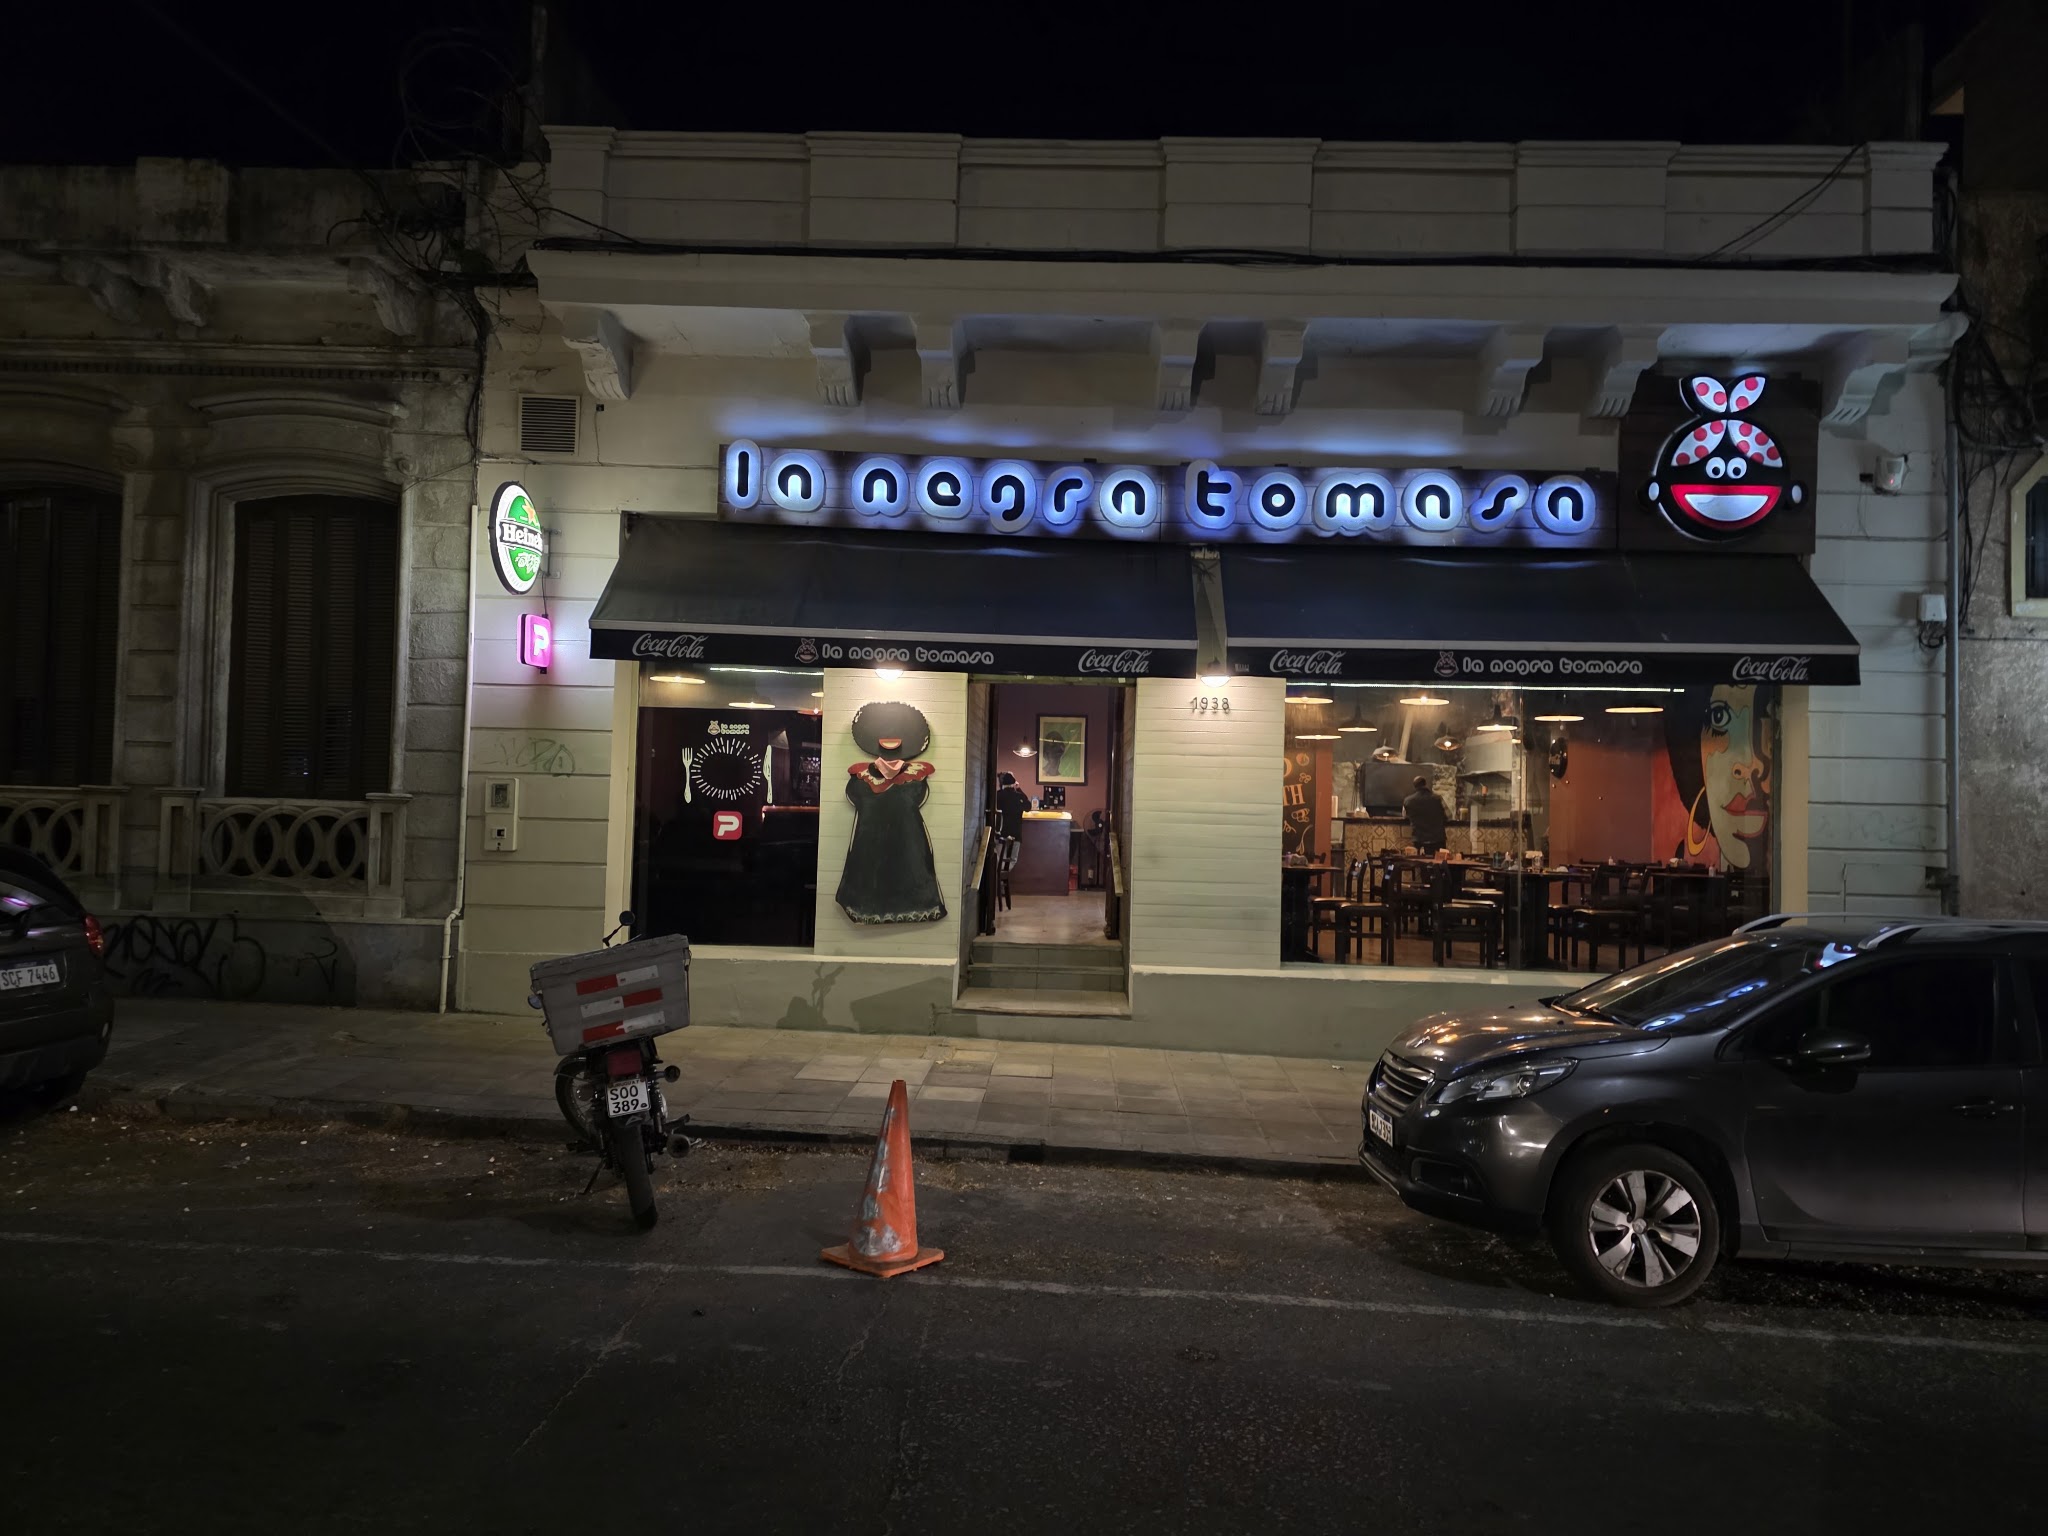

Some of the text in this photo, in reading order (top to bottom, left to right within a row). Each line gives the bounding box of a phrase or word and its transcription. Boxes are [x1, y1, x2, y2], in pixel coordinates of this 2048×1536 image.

[733, 446, 1589, 528] la negra tomasa
[632, 632, 709, 659] Coca-Cola
[822, 643, 994, 665] la negra tomasa
[1077, 648, 1152, 673] Coca-Cola
[1269, 648, 1347, 675] Coca-Cola
[1463, 656, 1643, 676] la negra tomasa
[1732, 655, 1811, 681] Coca-Cola
[1193, 696, 1230, 711] 1938
[1, 966, 56, 987] SCF 7446
[612, 1098, 639, 1114] 389
